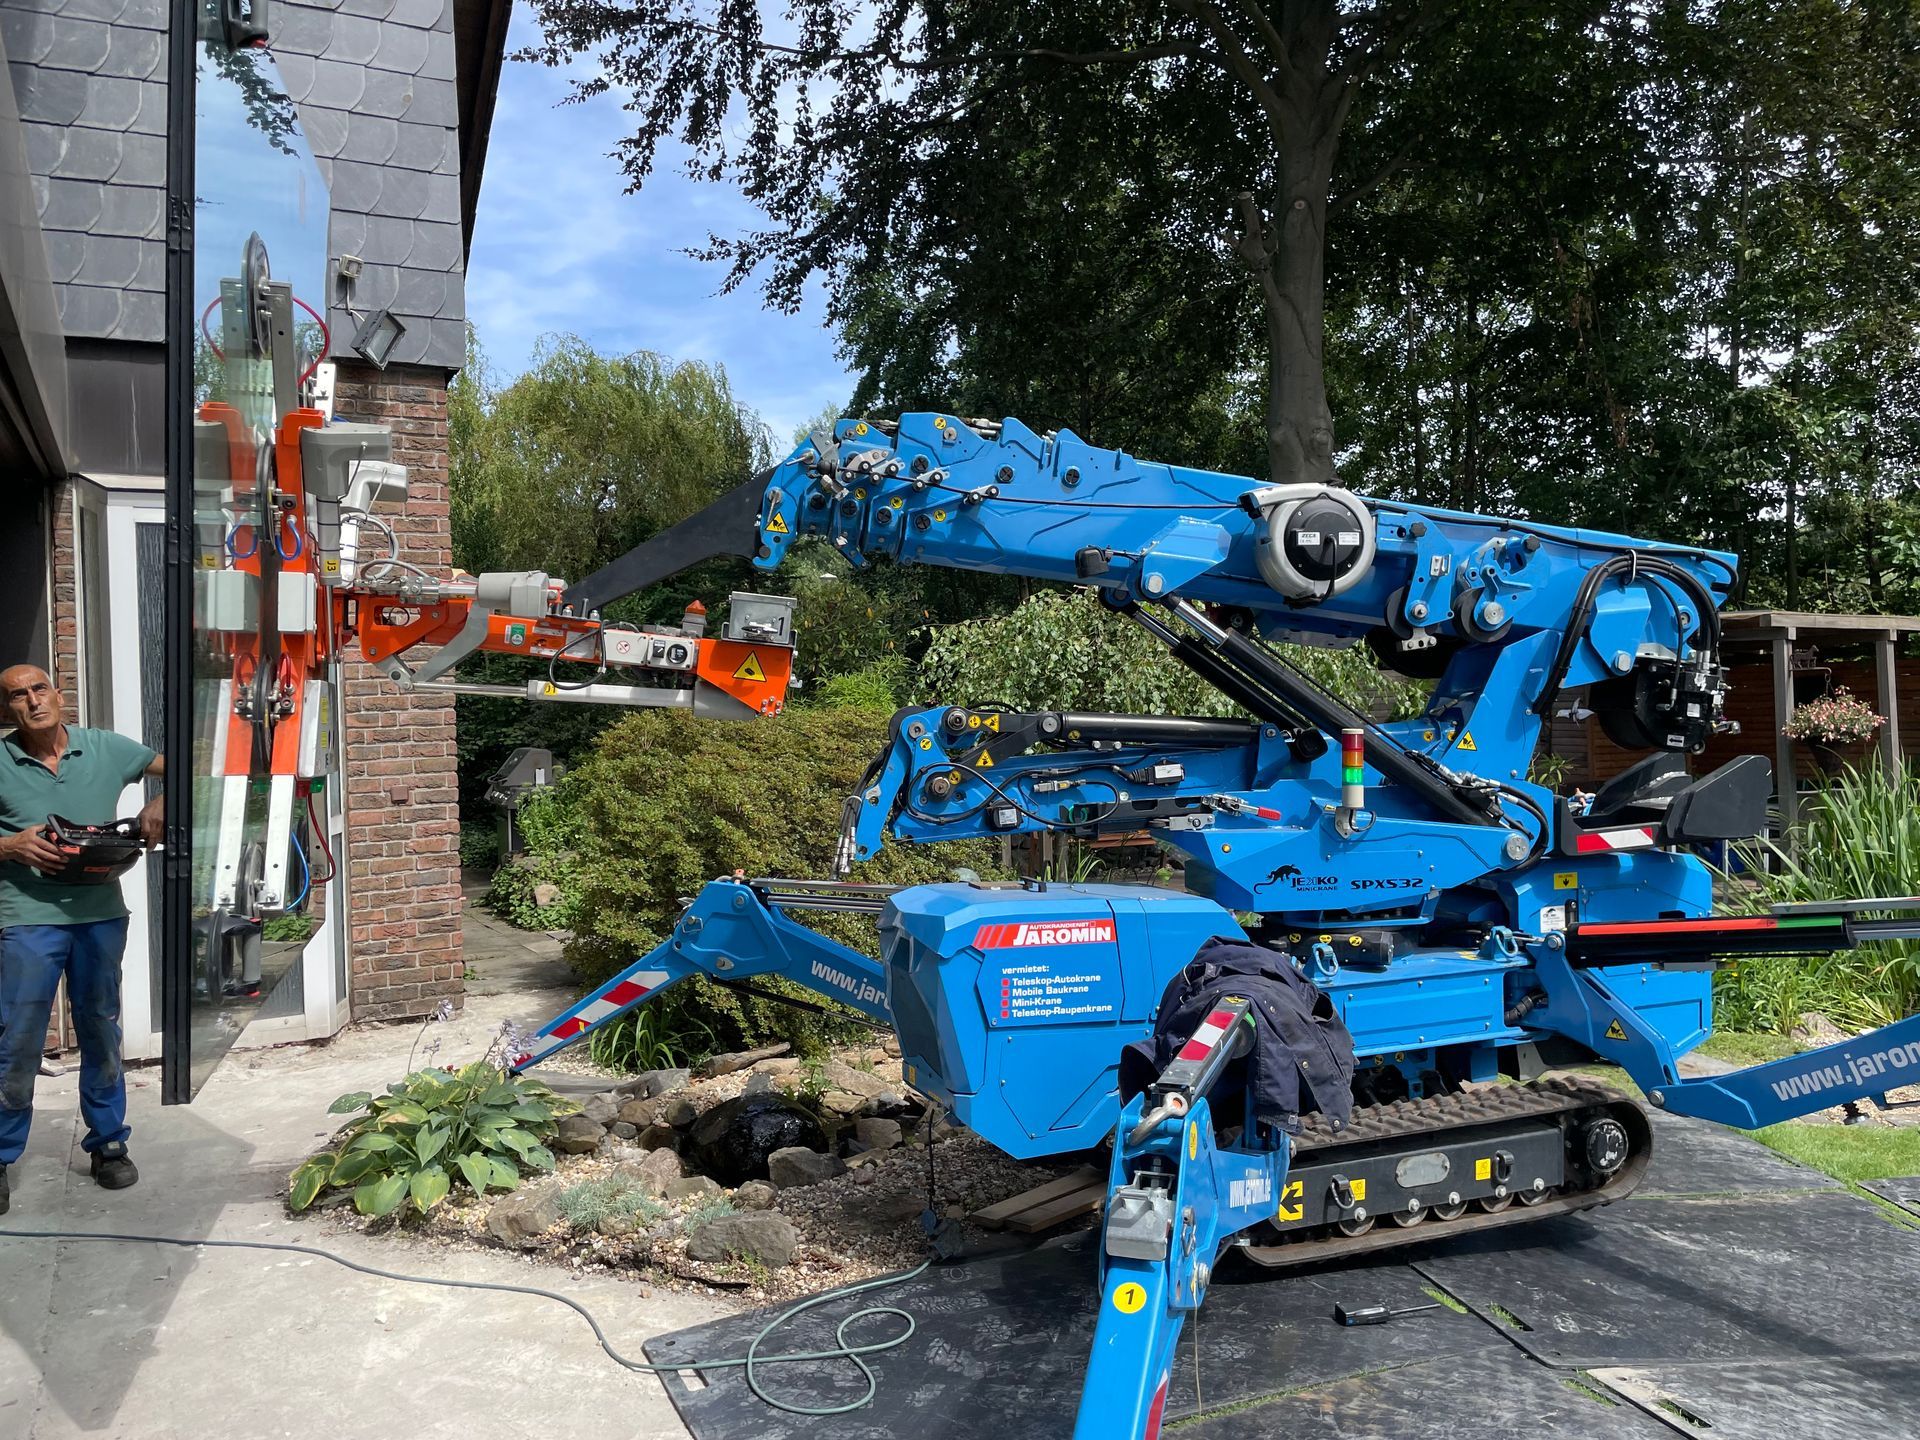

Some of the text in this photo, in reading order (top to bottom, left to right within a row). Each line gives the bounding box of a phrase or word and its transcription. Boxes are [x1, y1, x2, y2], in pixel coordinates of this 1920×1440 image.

[327, 560, 336, 571] J3
[778, 617, 785, 636] 1
[1013, 924, 1111, 946] JAROMIN
[1002, 965, 1050, 974] vermietet:
[1012, 975, 1101, 987] Teleskop-Autokrane
[1012, 986, 1089, 997] Mobile Baukrane
[1012, 998, 1062, 1007] Mini-Krane
[1012, 1005, 1112, 1018] Teleskop-Raupenkrane
[1125, 1288, 1135, 1305] 1
